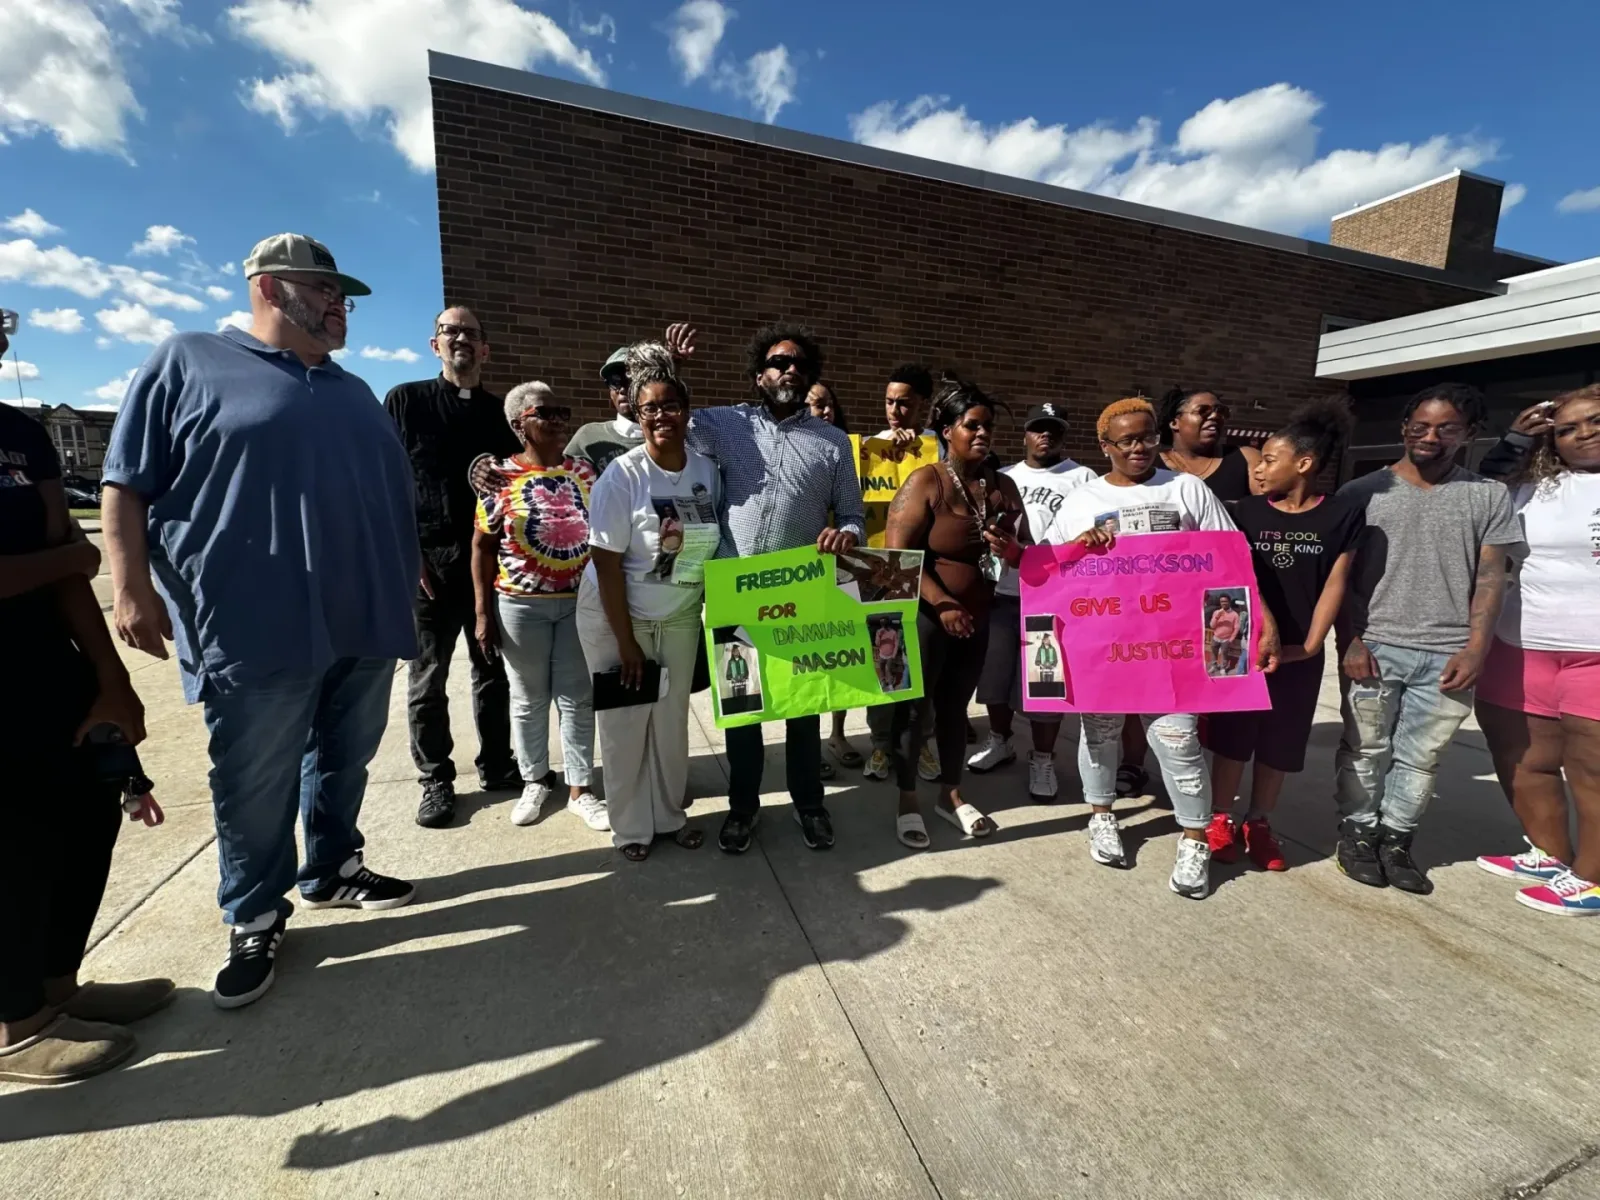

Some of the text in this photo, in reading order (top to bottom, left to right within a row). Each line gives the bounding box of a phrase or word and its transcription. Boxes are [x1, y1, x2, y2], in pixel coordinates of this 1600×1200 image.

[859, 476, 897, 491] INAL
[1253, 542, 1324, 554] TO BE KIND
[1259, 530, 1321, 542] IT'S COOL
[735, 558, 825, 593] FREEDOM
[1059, 552, 1213, 577] FREDRICKSON
[757, 602, 797, 622] FOR
[1069, 592, 1172, 617] GIVE US
[772, 619, 856, 646] DAMIAN
[791, 647, 866, 676] MASON
[1106, 639, 1195, 663] JUSTICE
